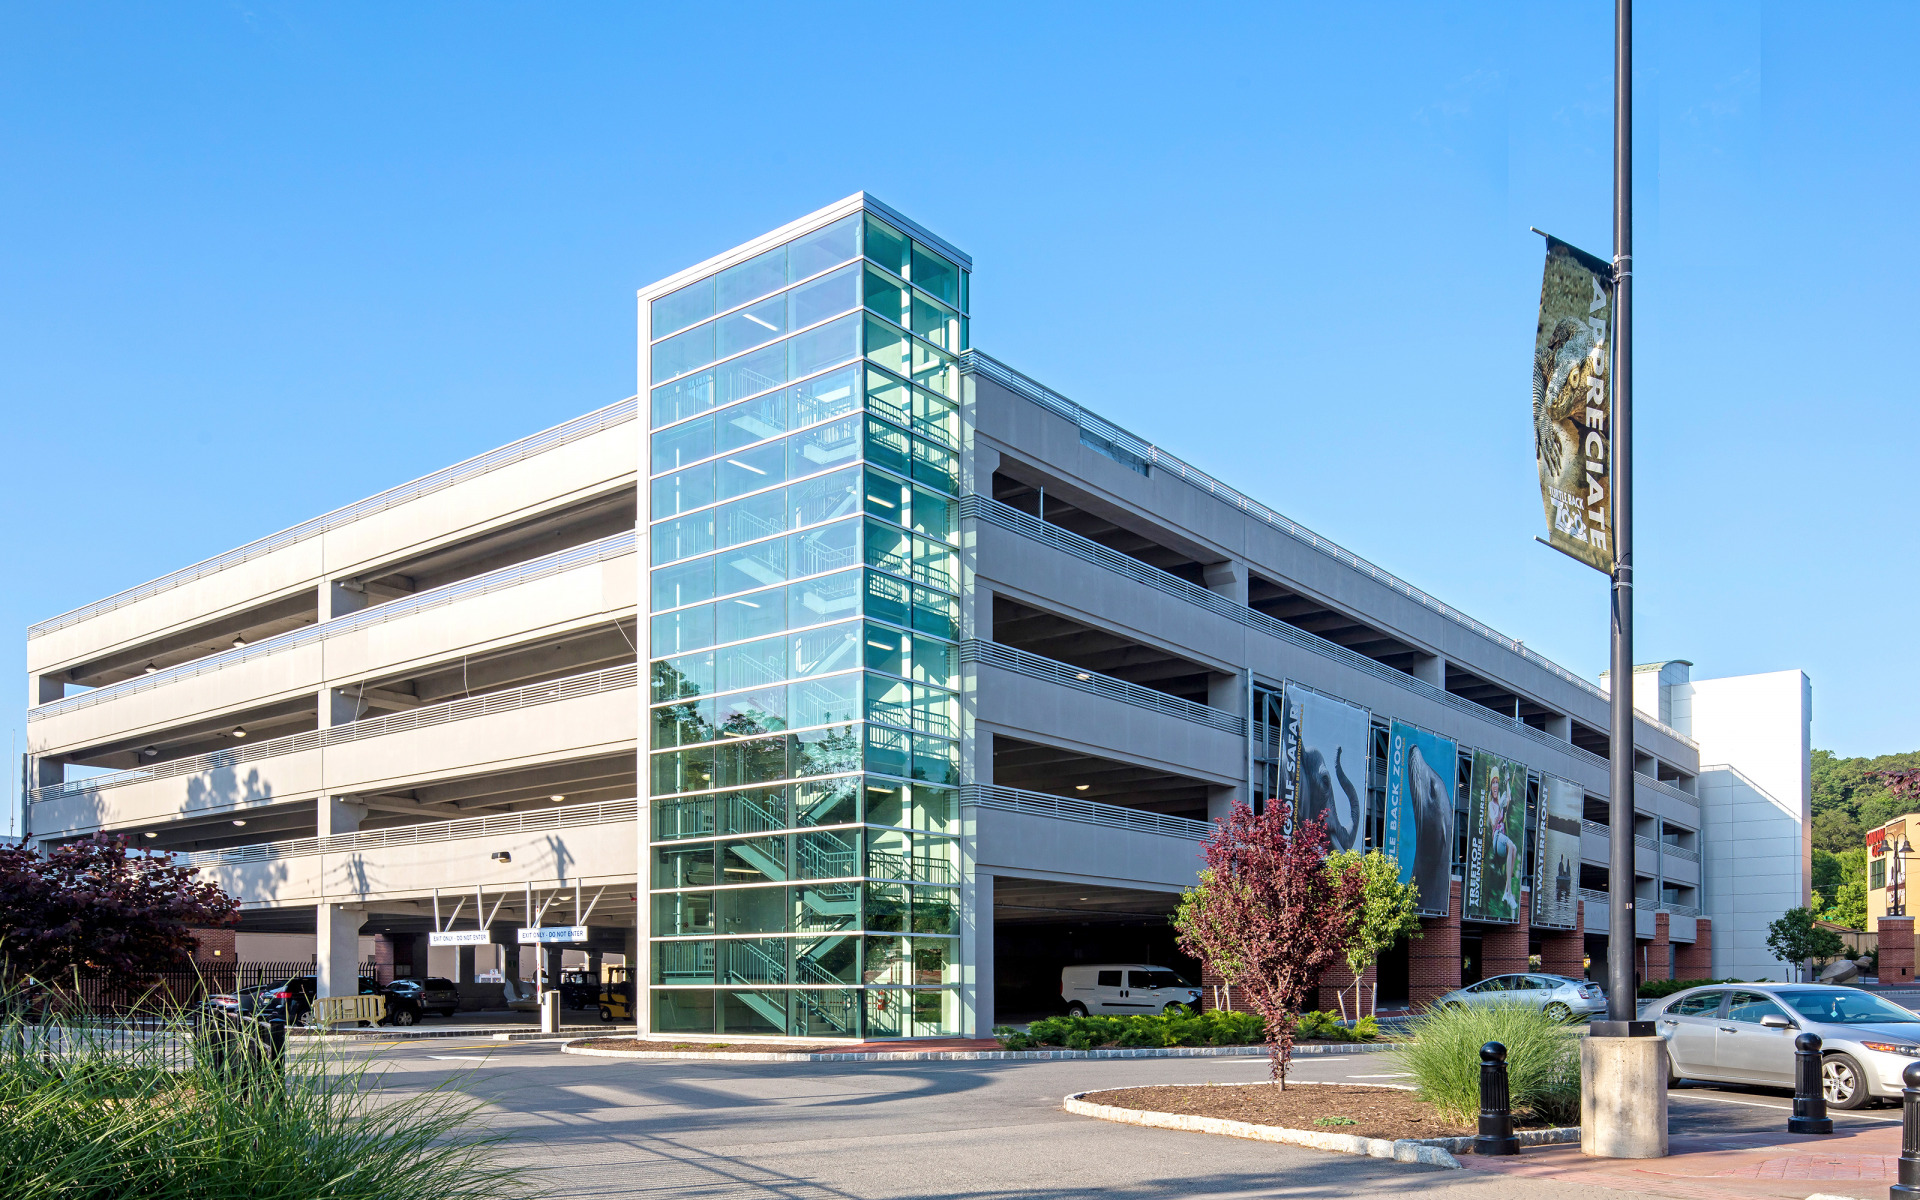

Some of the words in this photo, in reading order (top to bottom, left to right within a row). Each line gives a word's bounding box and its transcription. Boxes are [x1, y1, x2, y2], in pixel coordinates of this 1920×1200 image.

[1585, 276, 1607, 551] APPRECIATE
[1548, 486, 1568, 504] TURTLE
[1568, 494, 1584, 510] BACK
[1286, 701, 1299, 773] SAFARI
[1393, 735, 1402, 776] ZOO
[1390, 783, 1399, 830] BACK
[1478, 789, 1486, 835] COURSE
[1537, 785, 1548, 891] WATERFRONT
[1469, 837, 1478, 907] TREETOP
[1474, 838, 1483, 907] ADVENTURE
[1625, 902, 1633, 910] 10
